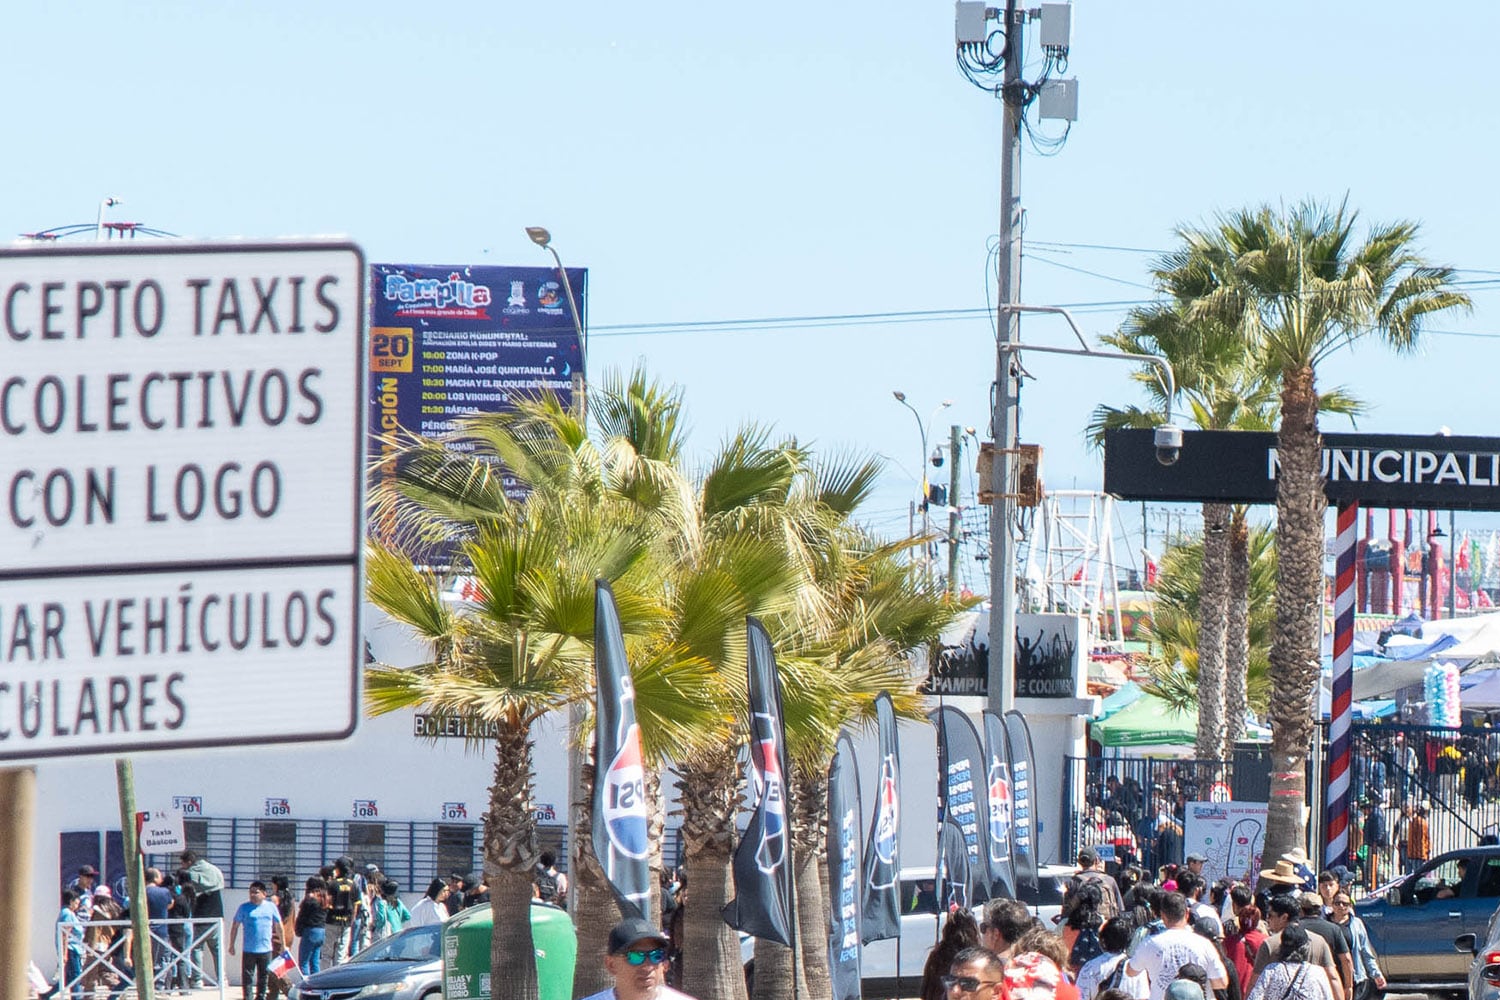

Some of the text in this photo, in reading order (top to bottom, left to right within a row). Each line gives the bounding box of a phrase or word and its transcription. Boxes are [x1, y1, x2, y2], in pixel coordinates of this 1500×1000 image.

[386, 272, 491, 308] Pampilla
[5, 275, 340, 341] CEPTO TAXIS
[422, 331, 469, 339] ESCENARIO
[373, 334, 409, 357] 20
[446, 352, 470, 360] ZONA
[379, 358, 403, 367] SEPT
[422, 364, 556, 375] 17:00 MARÍA JOSÉ QUINTANILLA
[445, 379, 476, 387] MACHA
[482, 379, 492, 387] EL
[447, 392, 465, 400] LOS
[0, 368, 322, 435] COLECTIVOS
[9, 461, 281, 529] CON LOGO
[84, 582, 335, 657] VEHÍCULOS
[932, 676, 988, 693] PAMPIL
[1029, 679, 1075, 695] COQUIMBO
[183, 804, 194, 813] 10
[271, 805, 286, 815] 09
[359, 807, 374, 817] 08
[448, 809, 462, 818] 07
[537, 811, 551, 820] 06
[465, 974, 472, 982] Y
